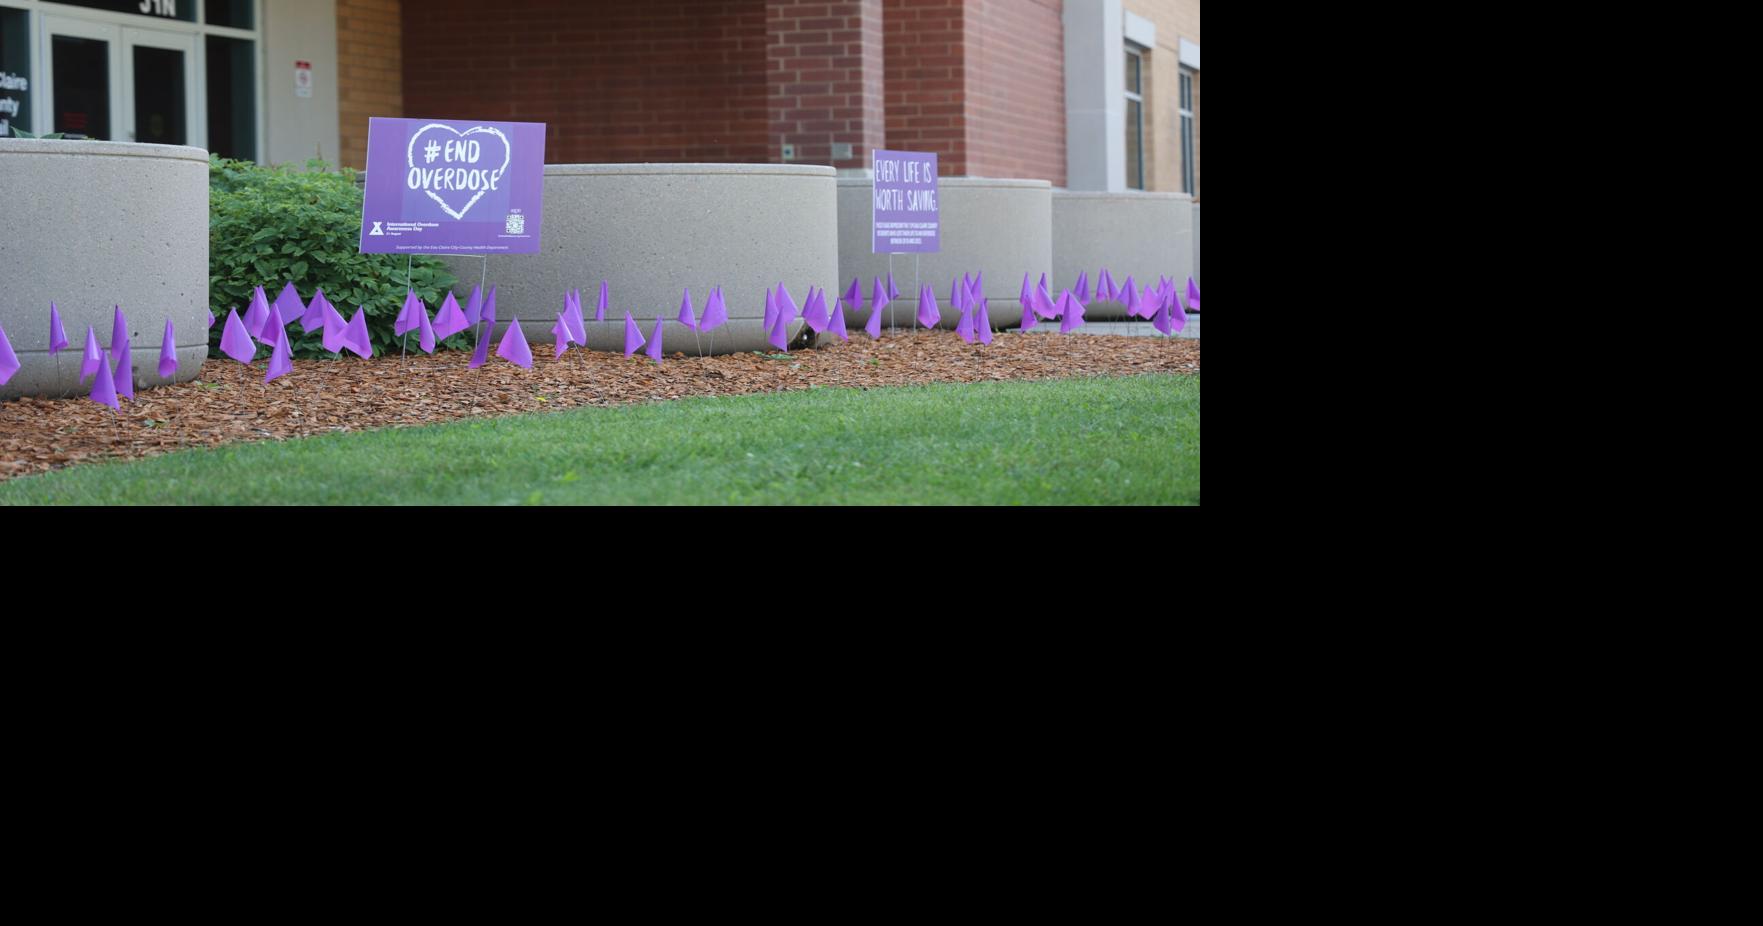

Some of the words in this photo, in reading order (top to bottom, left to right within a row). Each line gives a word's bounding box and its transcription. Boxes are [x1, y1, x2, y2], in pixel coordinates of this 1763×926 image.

[424, 140, 480, 164] #END
[407, 167, 500, 191] OVERDOSE
[876, 160, 900, 182] EVERY
[903, 160, 920, 183] LIFE
[923, 162, 931, 183] IS
[875, 189, 903, 211] WORTH
